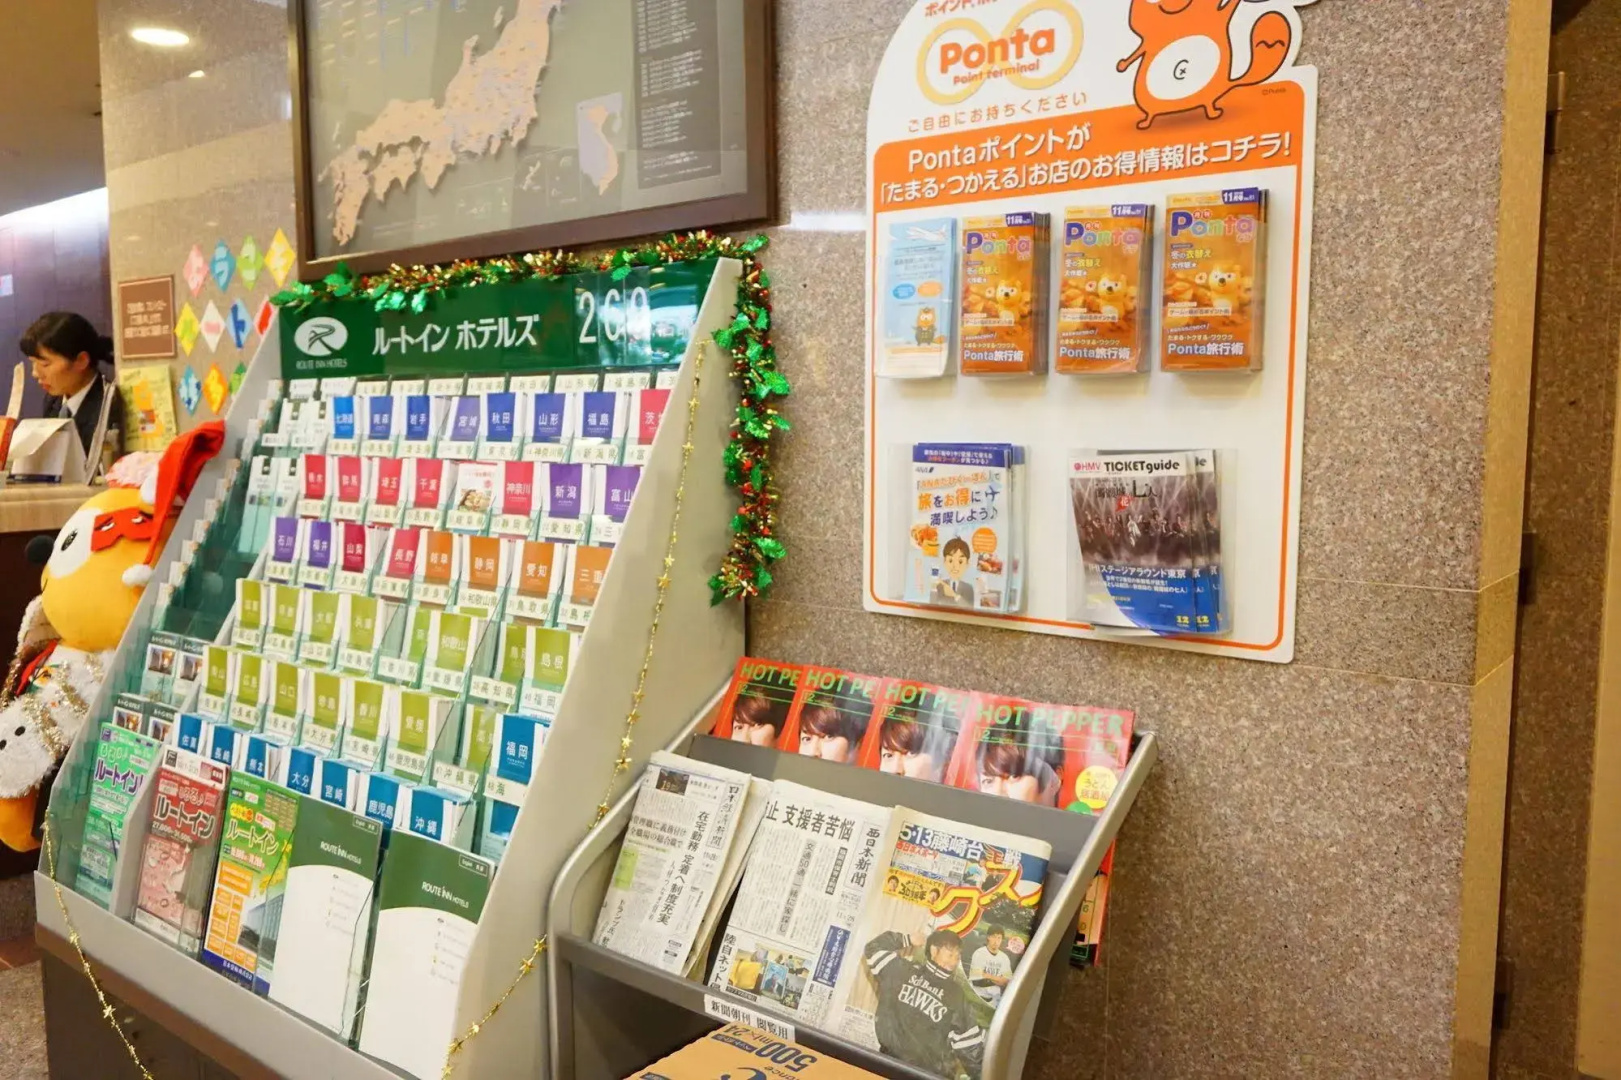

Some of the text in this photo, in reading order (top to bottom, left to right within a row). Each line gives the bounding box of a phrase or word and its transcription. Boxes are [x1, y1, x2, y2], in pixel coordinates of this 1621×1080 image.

[939, 28, 1056, 75] Ponta
[953, 59, 1040, 85] Point terminal
[907, 91, 1089, 134] ご自由にお持ちください
[908, 121, 1092, 173] Pontaポイントが
[1065, 222, 1143, 247] Ponta
[1170, 210, 1256, 237] Ponta
[966, 232, 1032, 255] Ponta
[372, 313, 541, 356] ルートイン ホテルズ
[964, 350, 1024, 362] Ponta旅行術
[1059, 346, 1130, 361] Ponta旅行術
[1167, 342, 1244, 355] Ponta旅行術
[409, 413, 427, 424] 岩手
[492, 412, 510, 424] 秋田
[538, 413, 559, 425] 山形
[587, 413, 610, 426] 福島
[1082, 460, 1180, 474] HMV TICKETguide
[419, 478, 438, 490] 千葉
[506, 482, 531, 494] 神奈川
[554, 485, 577, 500] 新潟
[918, 488, 982, 511] 旅をお得に
[394, 549, 413, 562] 長野
[474, 557, 495, 571] 静岡
[525, 563, 548, 577] 愛知
[541, 652, 564, 669] 島根
[740, 662, 800, 687] HOT PE
[805, 669, 876, 698] HOT PE
[884, 681, 931, 706] HOT
[976, 703, 1124, 738] HOT PEPPER
[506, 740, 529, 760] 福岡
[291, 773, 310, 787] 大分
[153, 793, 216, 839] ルートイン
[368, 800, 394, 819] 鹿児島
[709, 785, 741, 848] 日本経済新聞
[415, 816, 438, 836] 沖縄
[686, 811, 710, 853] 在宅勤務
[782, 804, 856, 842] 支援者苦悩
[225, 817, 280, 856] ルートイン
[320, 840, 338, 856] ROUTE
[348, 854, 362, 865] HOTELS
[850, 827, 882, 889] 西日本新聞
[421, 881, 442, 897] ROUTE
[452, 896, 469, 908] HOTELS
[656, 854, 695, 926] 定着へ制度充実
[907, 974, 945, 999] SoftBank
[897, 983, 948, 1024] HAWKS
[711, 1000, 788, 1040] 新聞朝刊 閲覧用
